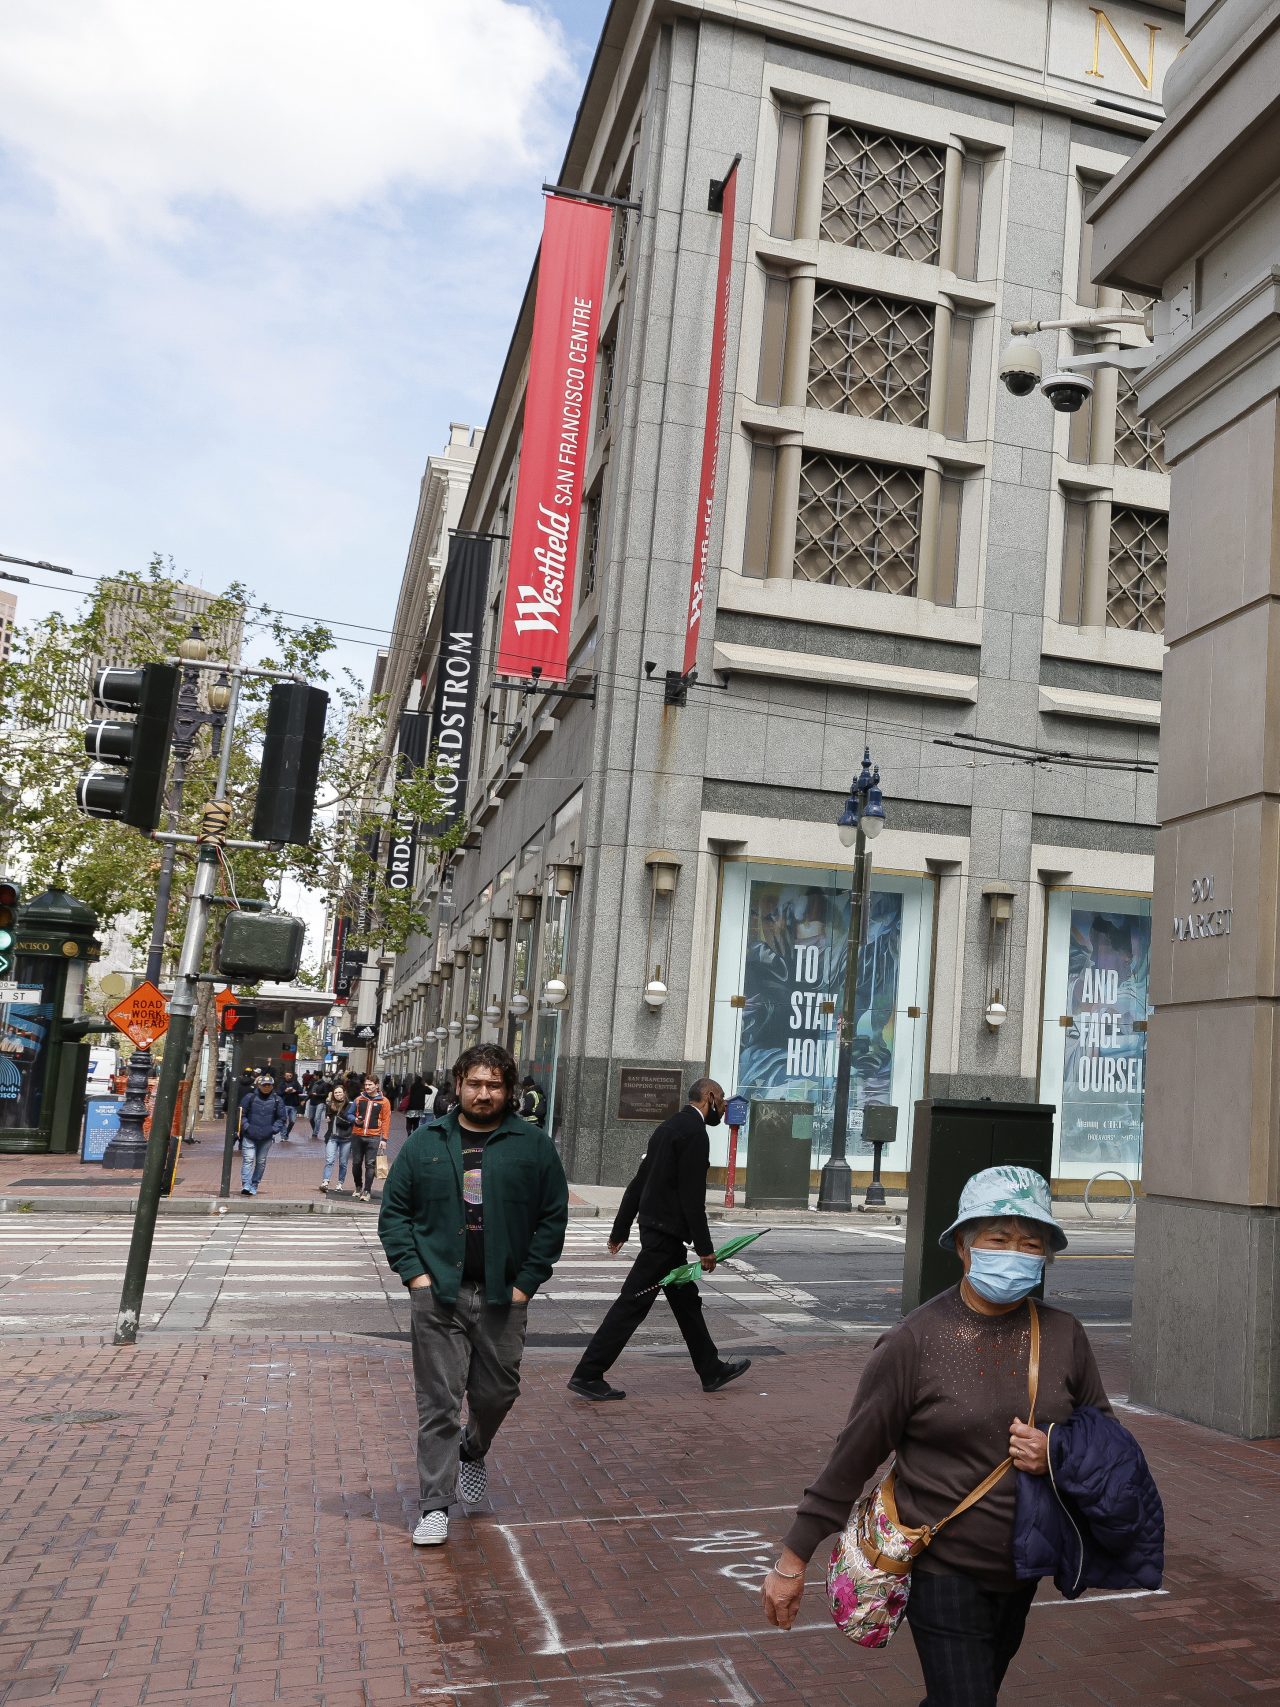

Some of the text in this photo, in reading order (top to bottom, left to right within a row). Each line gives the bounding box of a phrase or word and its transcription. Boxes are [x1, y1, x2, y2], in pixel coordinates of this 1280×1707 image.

[1085, 6, 1188, 91] N
[514, 296, 593, 636] Westfield SAN FRANCISCO CENTRE
[690, 496, 713, 630] Westfield
[432, 632, 474, 816] NORDSTROM
[1192, 875, 1214, 904] 901
[1171, 908, 1234, 943] MARKET
[793, 944, 820, 983] TO
[13, 992, 26, 1001] ST
[133, 1000, 163, 1009] ROAD
[1082, 967, 1119, 1004] AND
[128, 1019, 165, 1028] AHEAD
[131, 1009, 162, 1019] WORK
[789, 990, 839, 1031] STAY
[1079, 1011, 1122, 1049] FACE
[786, 1038, 841, 1078] HOM
[1078, 1055, 1146, 1093] OURSEL
